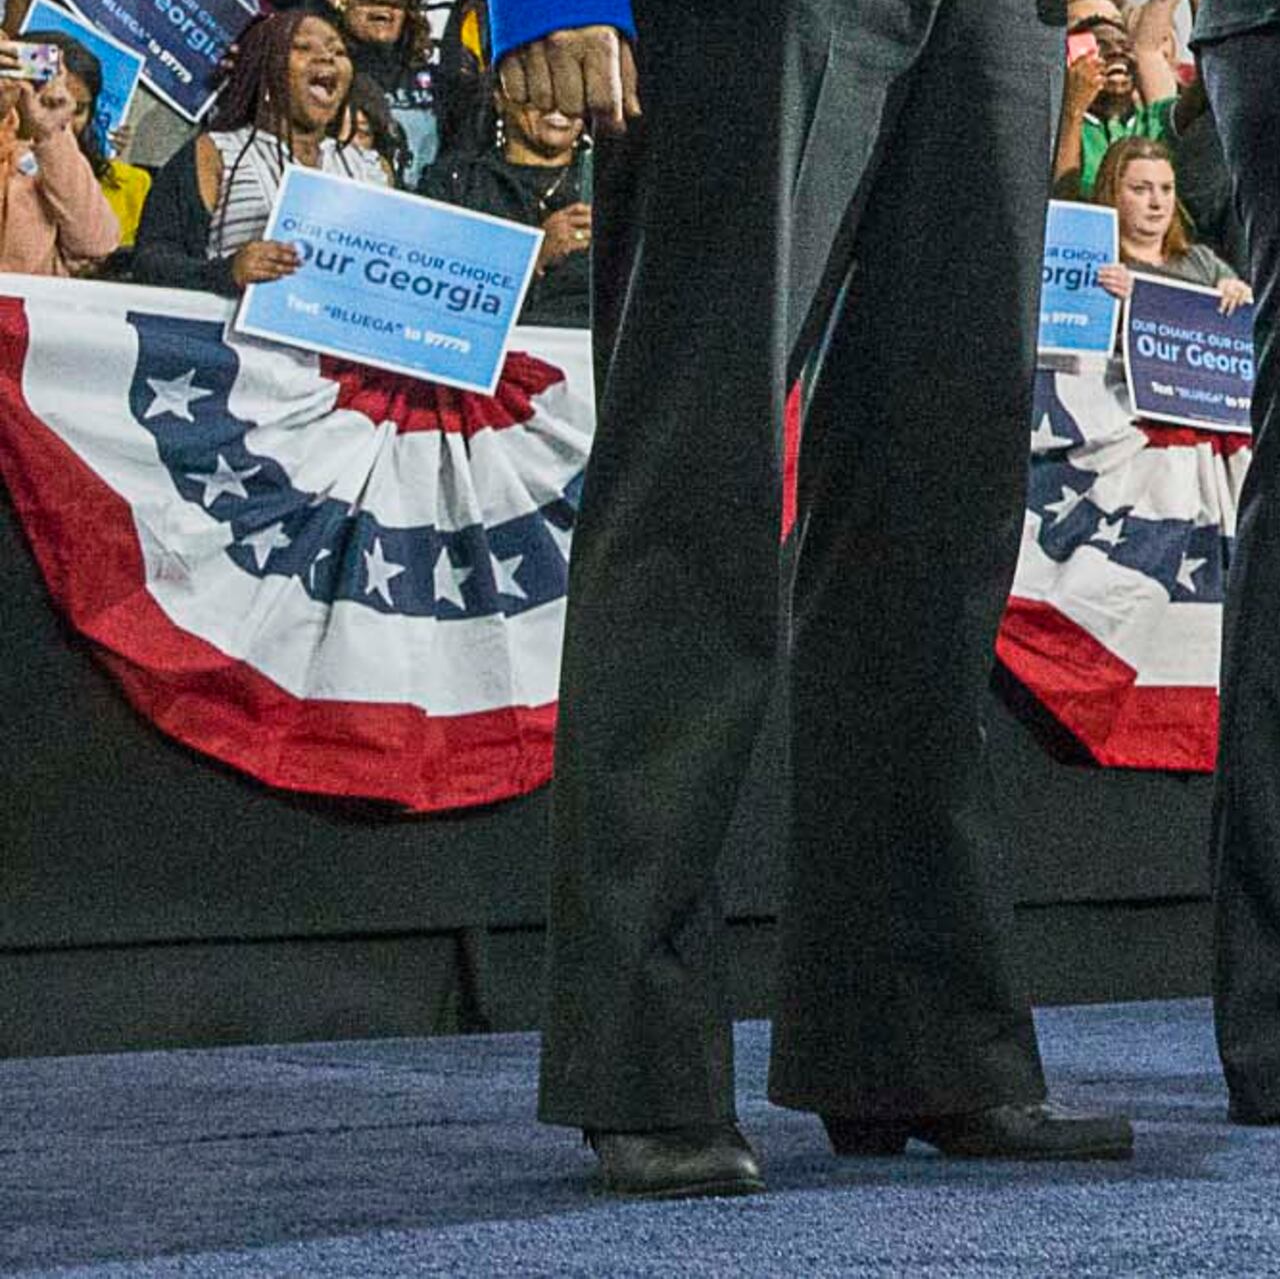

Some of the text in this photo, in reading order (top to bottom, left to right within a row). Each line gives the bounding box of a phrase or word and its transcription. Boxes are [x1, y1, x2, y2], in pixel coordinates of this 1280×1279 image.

[148, 38, 163, 56] to
[407, 249, 445, 271] OUR
[364, 257, 501, 316] Georgia
[286, 292, 321, 316] Text
[404, 325, 421, 342] to
[1131, 318, 1158, 334] OUR
[1207, 334, 1231, 349] OUR
[1136, 334, 1181, 363] Our
[1151, 380, 1175, 396] Text
[1225, 395, 1238, 409] to
